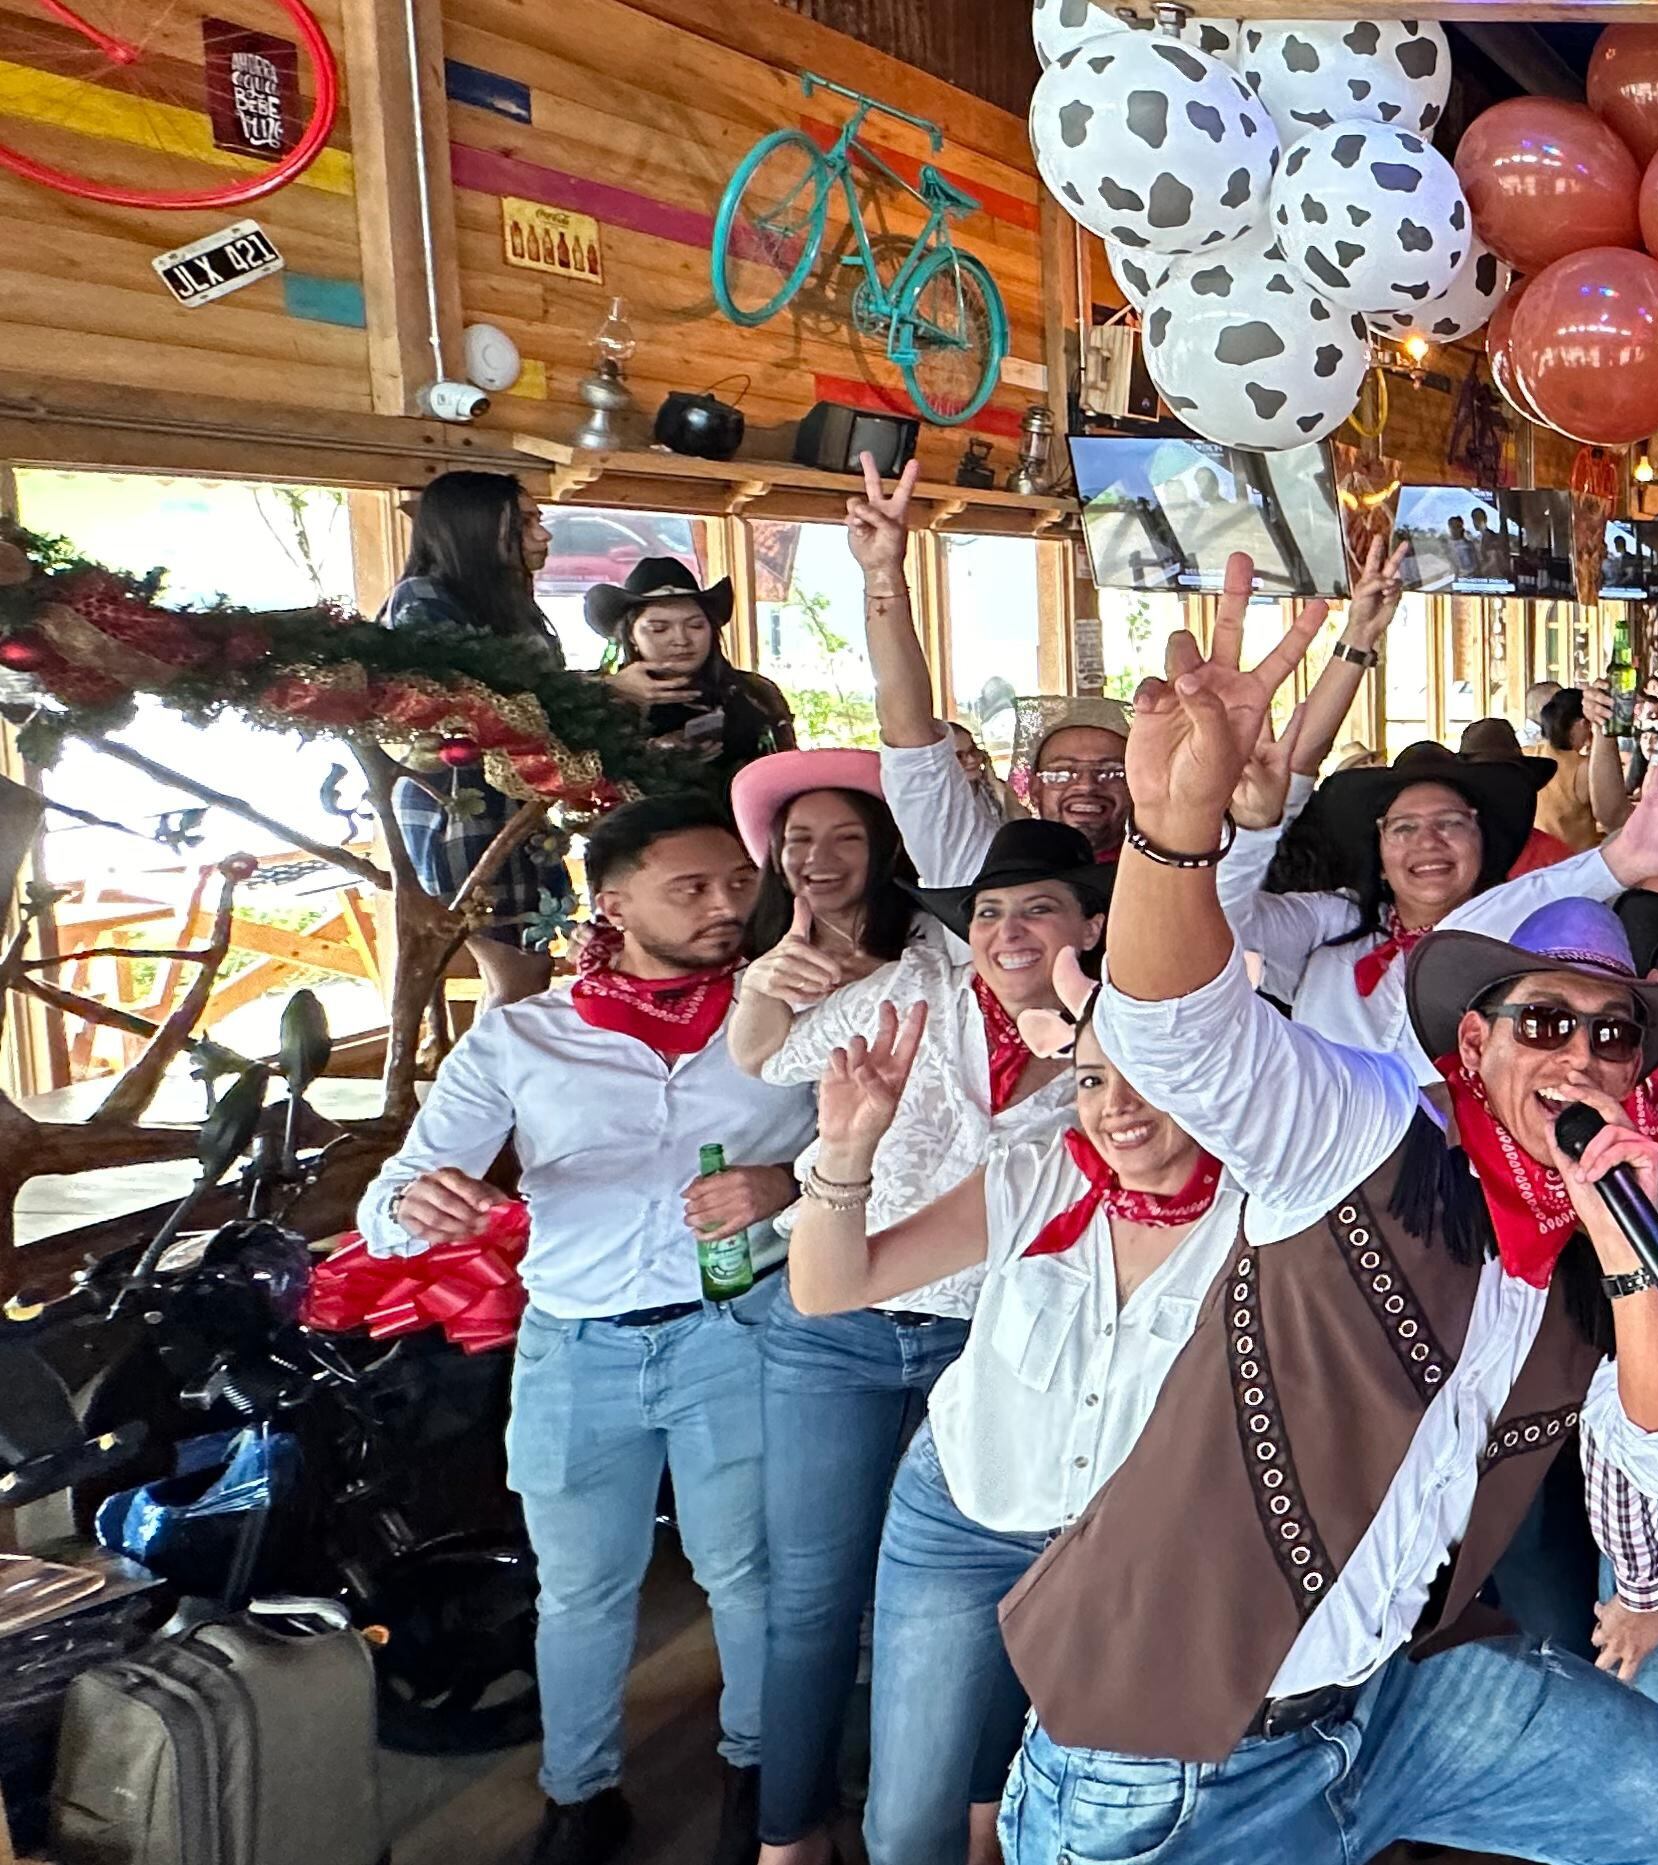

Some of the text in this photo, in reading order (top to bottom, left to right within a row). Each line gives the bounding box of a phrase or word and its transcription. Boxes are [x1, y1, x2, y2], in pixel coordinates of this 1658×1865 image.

[234, 87, 281, 119] BEBE
[172, 234, 276, 298] JLX 421
